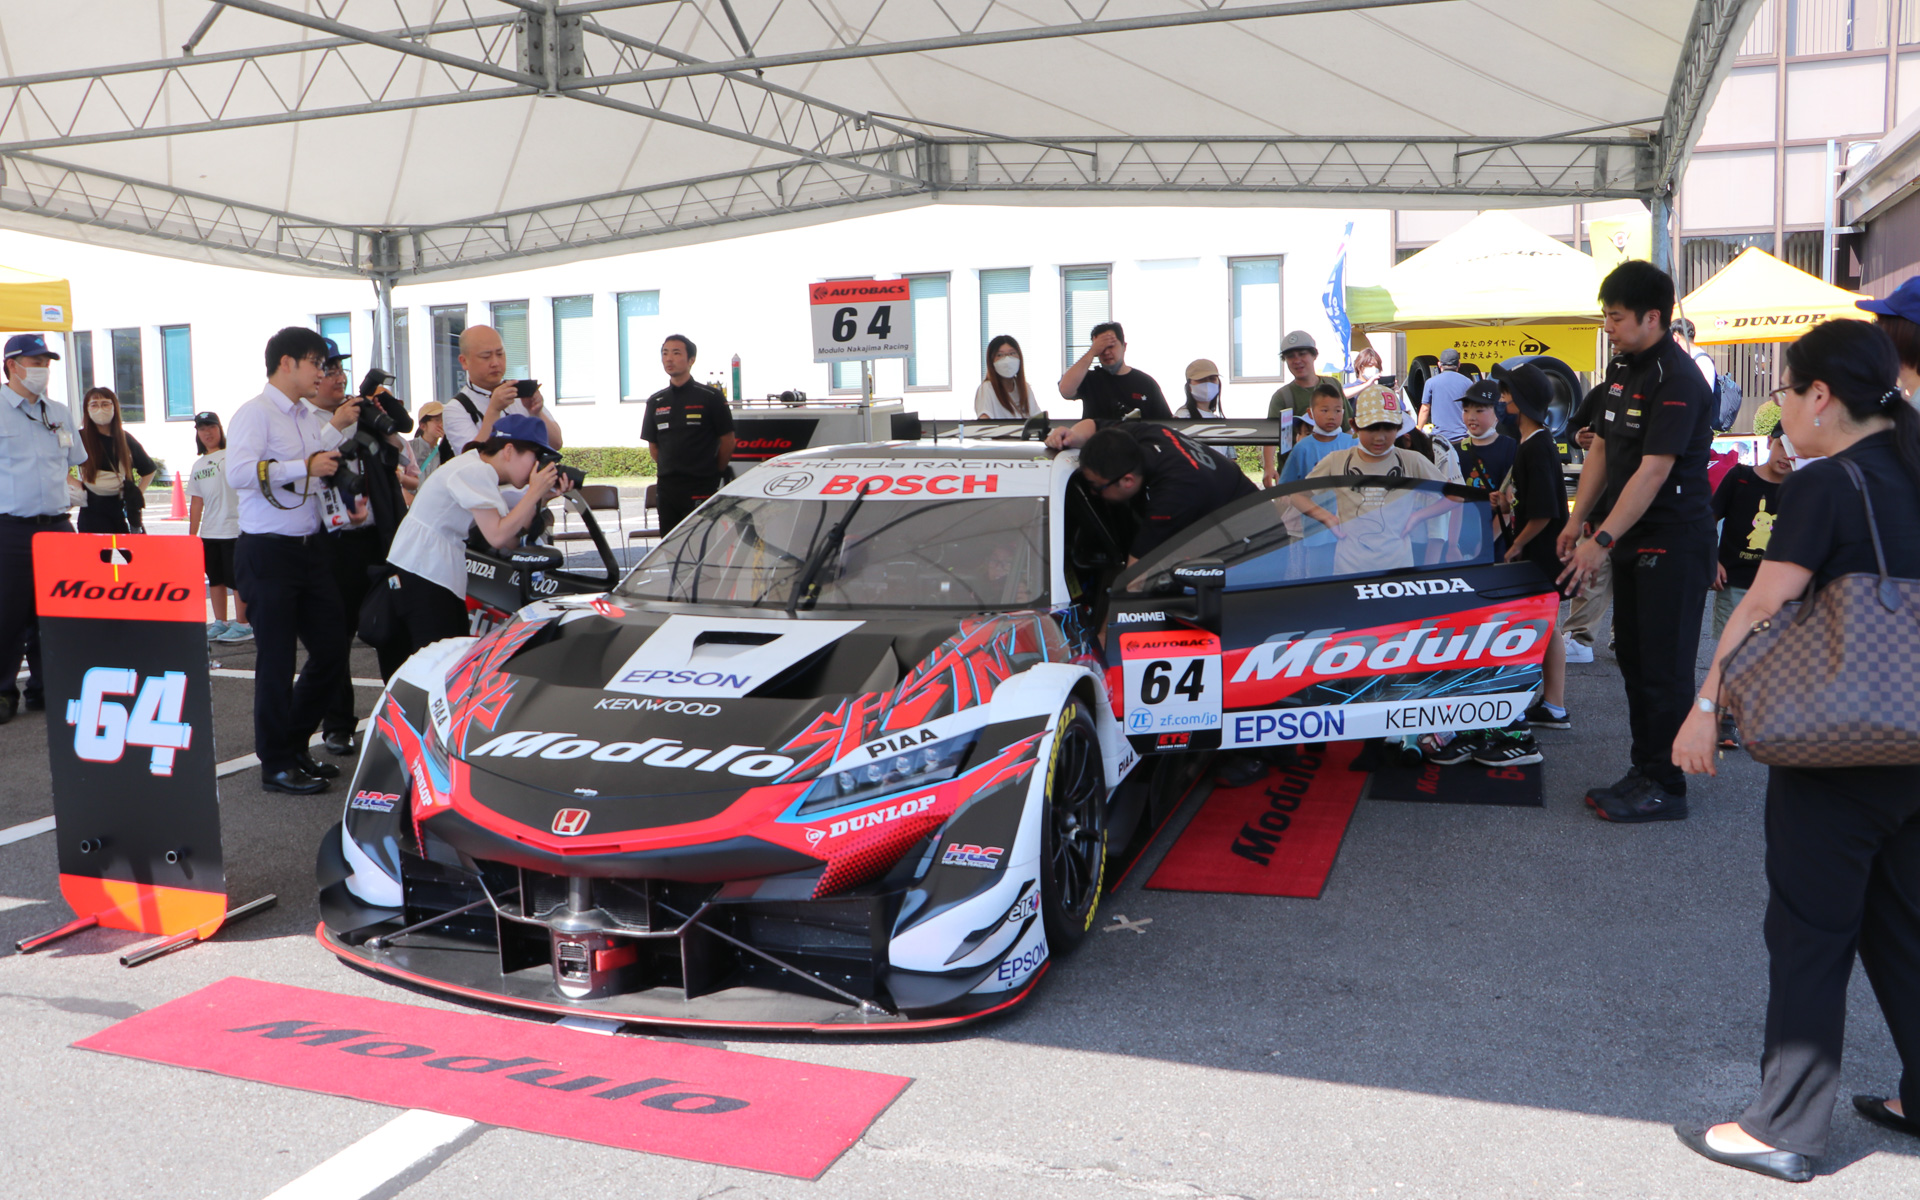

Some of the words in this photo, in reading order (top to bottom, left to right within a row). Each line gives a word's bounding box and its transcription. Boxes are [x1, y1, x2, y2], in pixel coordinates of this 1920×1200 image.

[830, 286, 905, 297] AUTOBACS
[1732, 313, 1826, 328] DUNLOP
[818, 347, 845, 355] Modulo
[847, 345, 881, 354] Nakajima
[883, 343, 909, 352] Racing
[1453, 339, 1516, 348] あなたのタイヤに
[1382, 392, 1398, 410] B
[803, 461, 906, 469] Honda
[914, 461, 1039, 469] RACING
[819, 474, 999, 496] BOSCH
[465, 558, 497, 580] ONDA
[511, 554, 550, 562] Modulo
[508, 570, 559, 595] KEOOD
[1174, 567, 1225, 577] Modulo
[50, 580, 191, 602] Modulo
[1354, 577, 1475, 600] HONDA
[1142, 638, 1215, 650] AUTOBACS
[1230, 620, 1538, 684] Modulo
[620, 670, 752, 689] EPSON
[1140, 658, 1205, 705] 64
[431, 697, 448, 727] PIAA
[593, 698, 722, 717] KENWOOD
[1386, 700, 1513, 730] KENWOOD
[66, 667, 193, 776] 64
[1160, 712, 1218, 727] zf.com/jp
[1234, 709, 1345, 744] EPSON
[865, 728, 939, 759] PIAA
[1158, 732, 1190, 745] ETS
[468, 731, 795, 777] Modulo
[1118, 750, 1134, 777] PIAA
[414, 763, 433, 807] DUNLOP
[352, 790, 401, 809] HRC
[1230, 754, 1322, 867] Modulo
[829, 794, 936, 838] DUNLOP
[943, 843, 1004, 864] HRC
[1008, 895, 1033, 922] elf
[998, 938, 1046, 981] EPSON
[227, 1019, 751, 1115] Modulo
